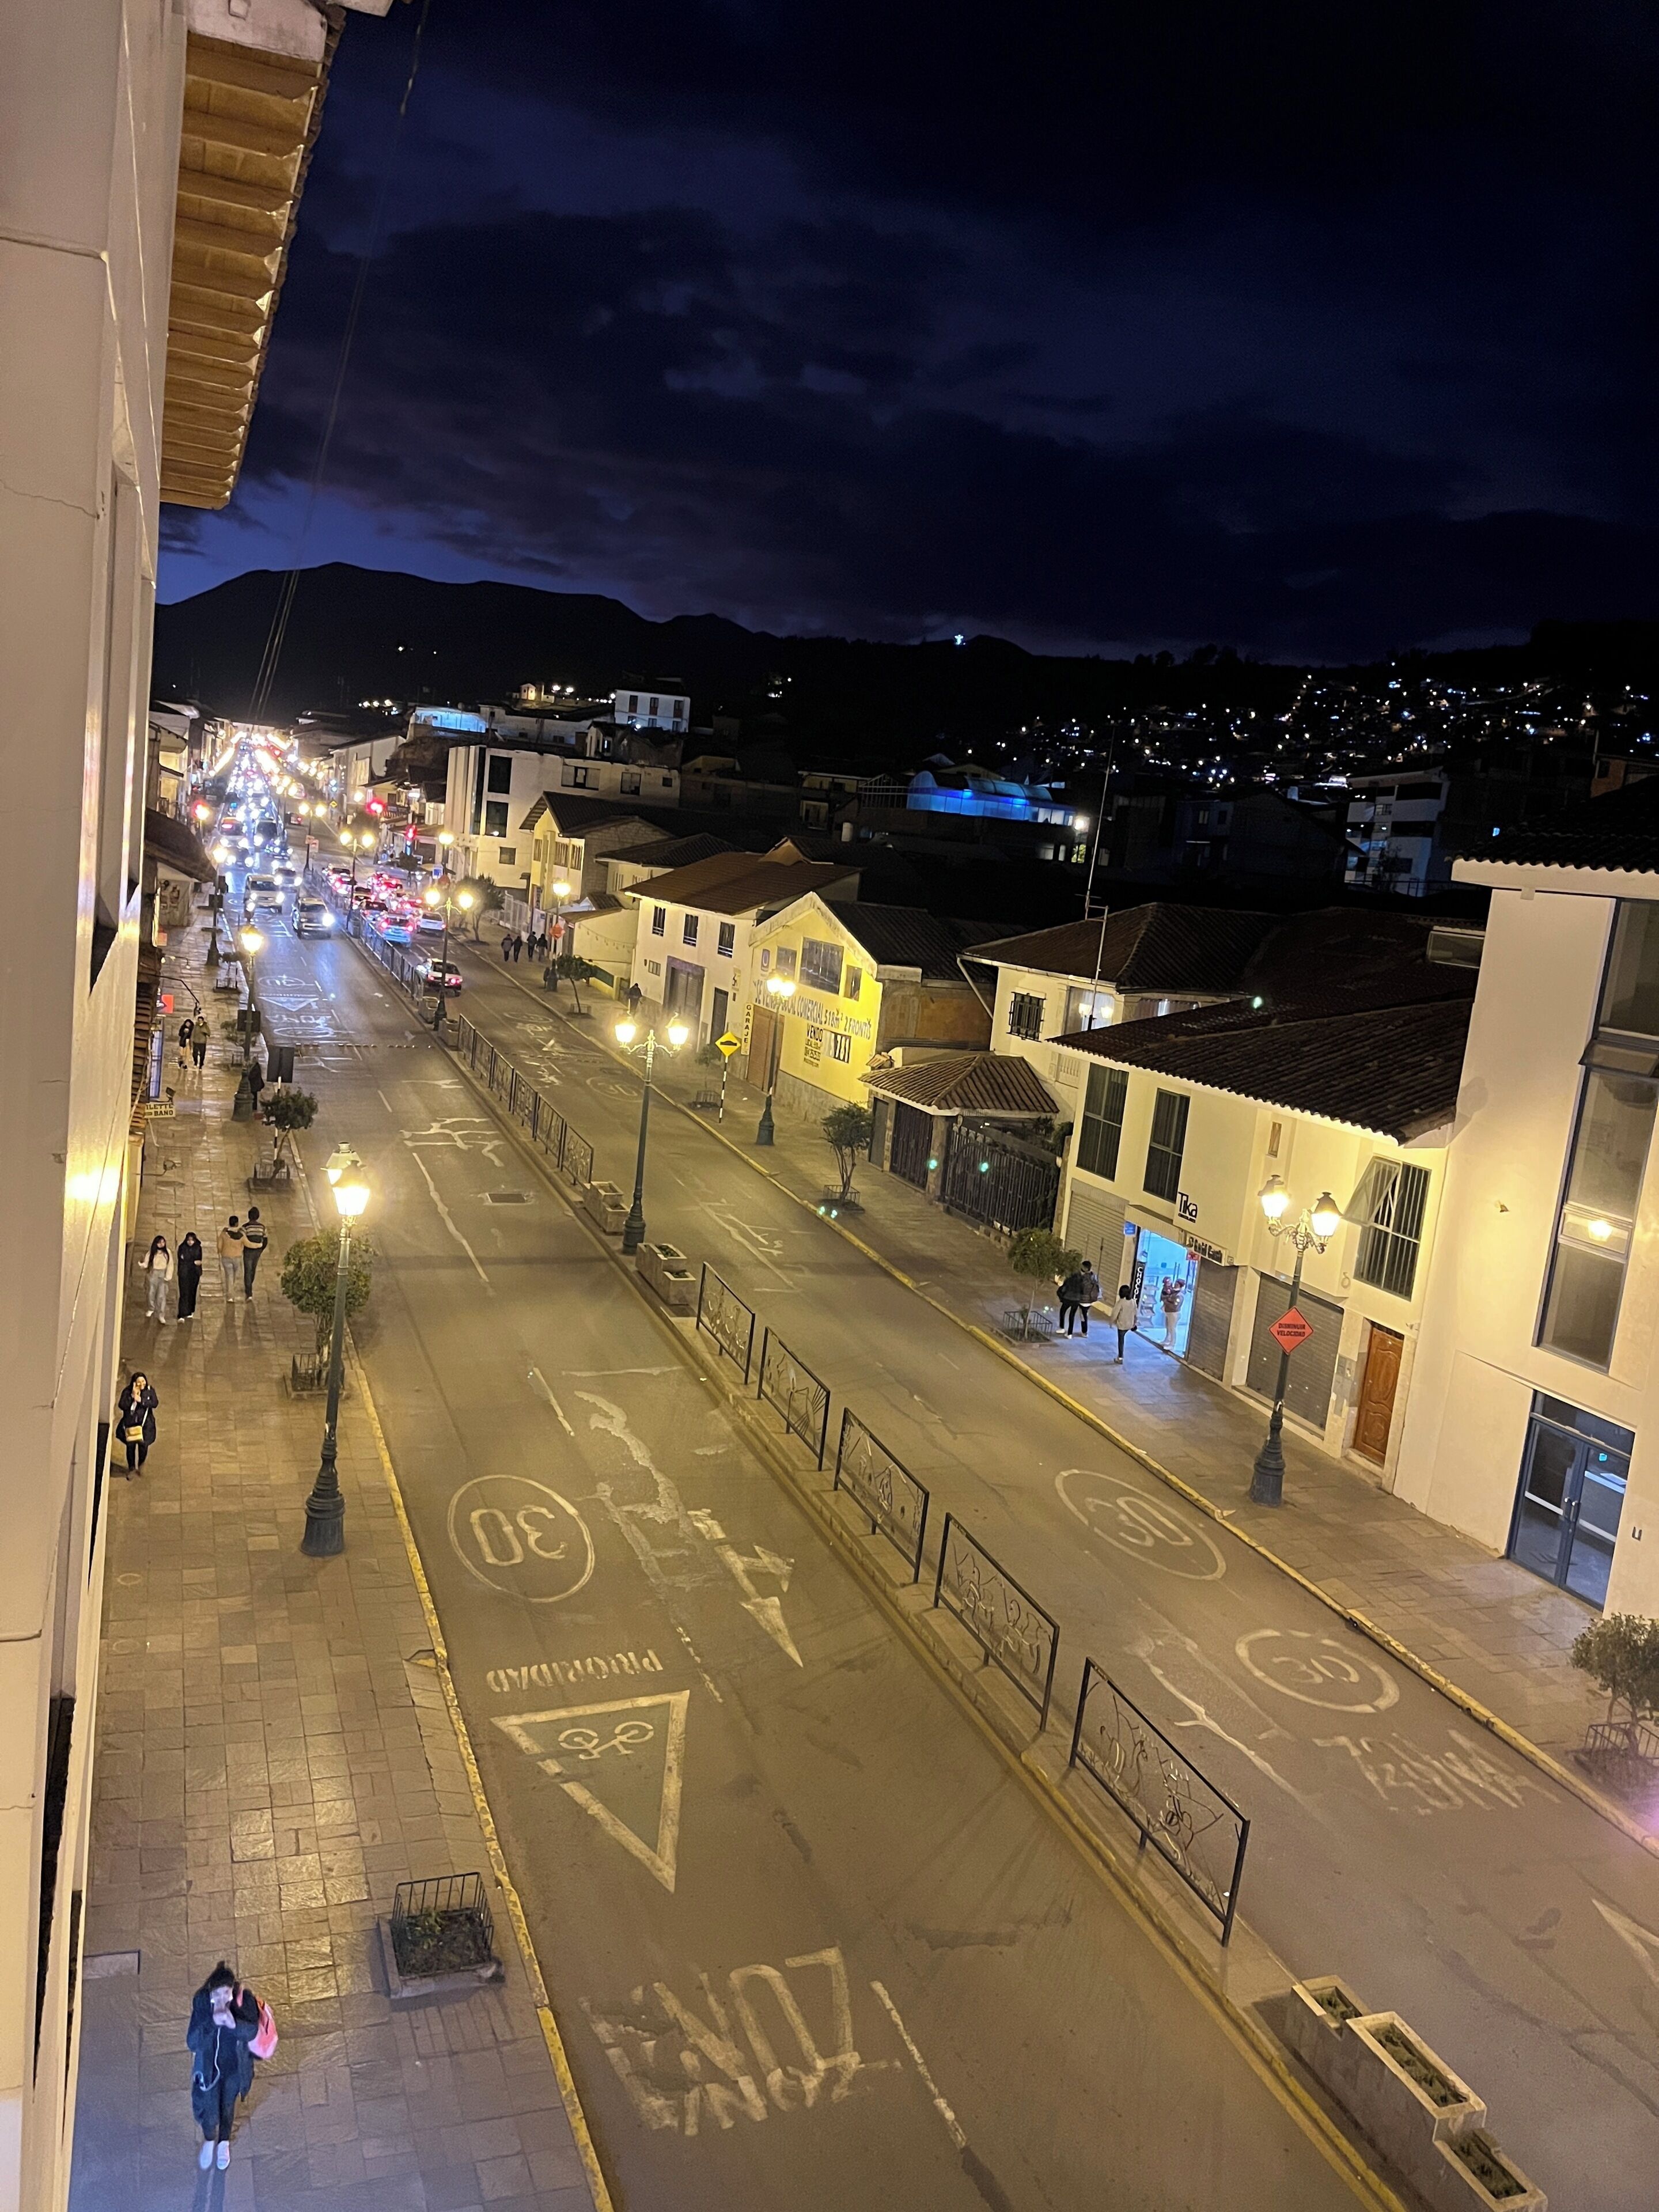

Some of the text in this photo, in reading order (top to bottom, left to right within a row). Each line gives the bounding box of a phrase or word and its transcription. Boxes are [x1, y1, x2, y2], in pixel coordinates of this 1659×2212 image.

[744, 1005, 752, 1043] GARAJE
[806, 1023, 823, 1043] VENDO
[1277, 1330, 1306, 1338] VELOCIDAD
[469, 1505, 565, 1566] 30
[1085, 1497, 1194, 1547] 30
[486, 1649, 664, 1693] PRIORIDAD
[1272, 1655, 1359, 1684] 30
